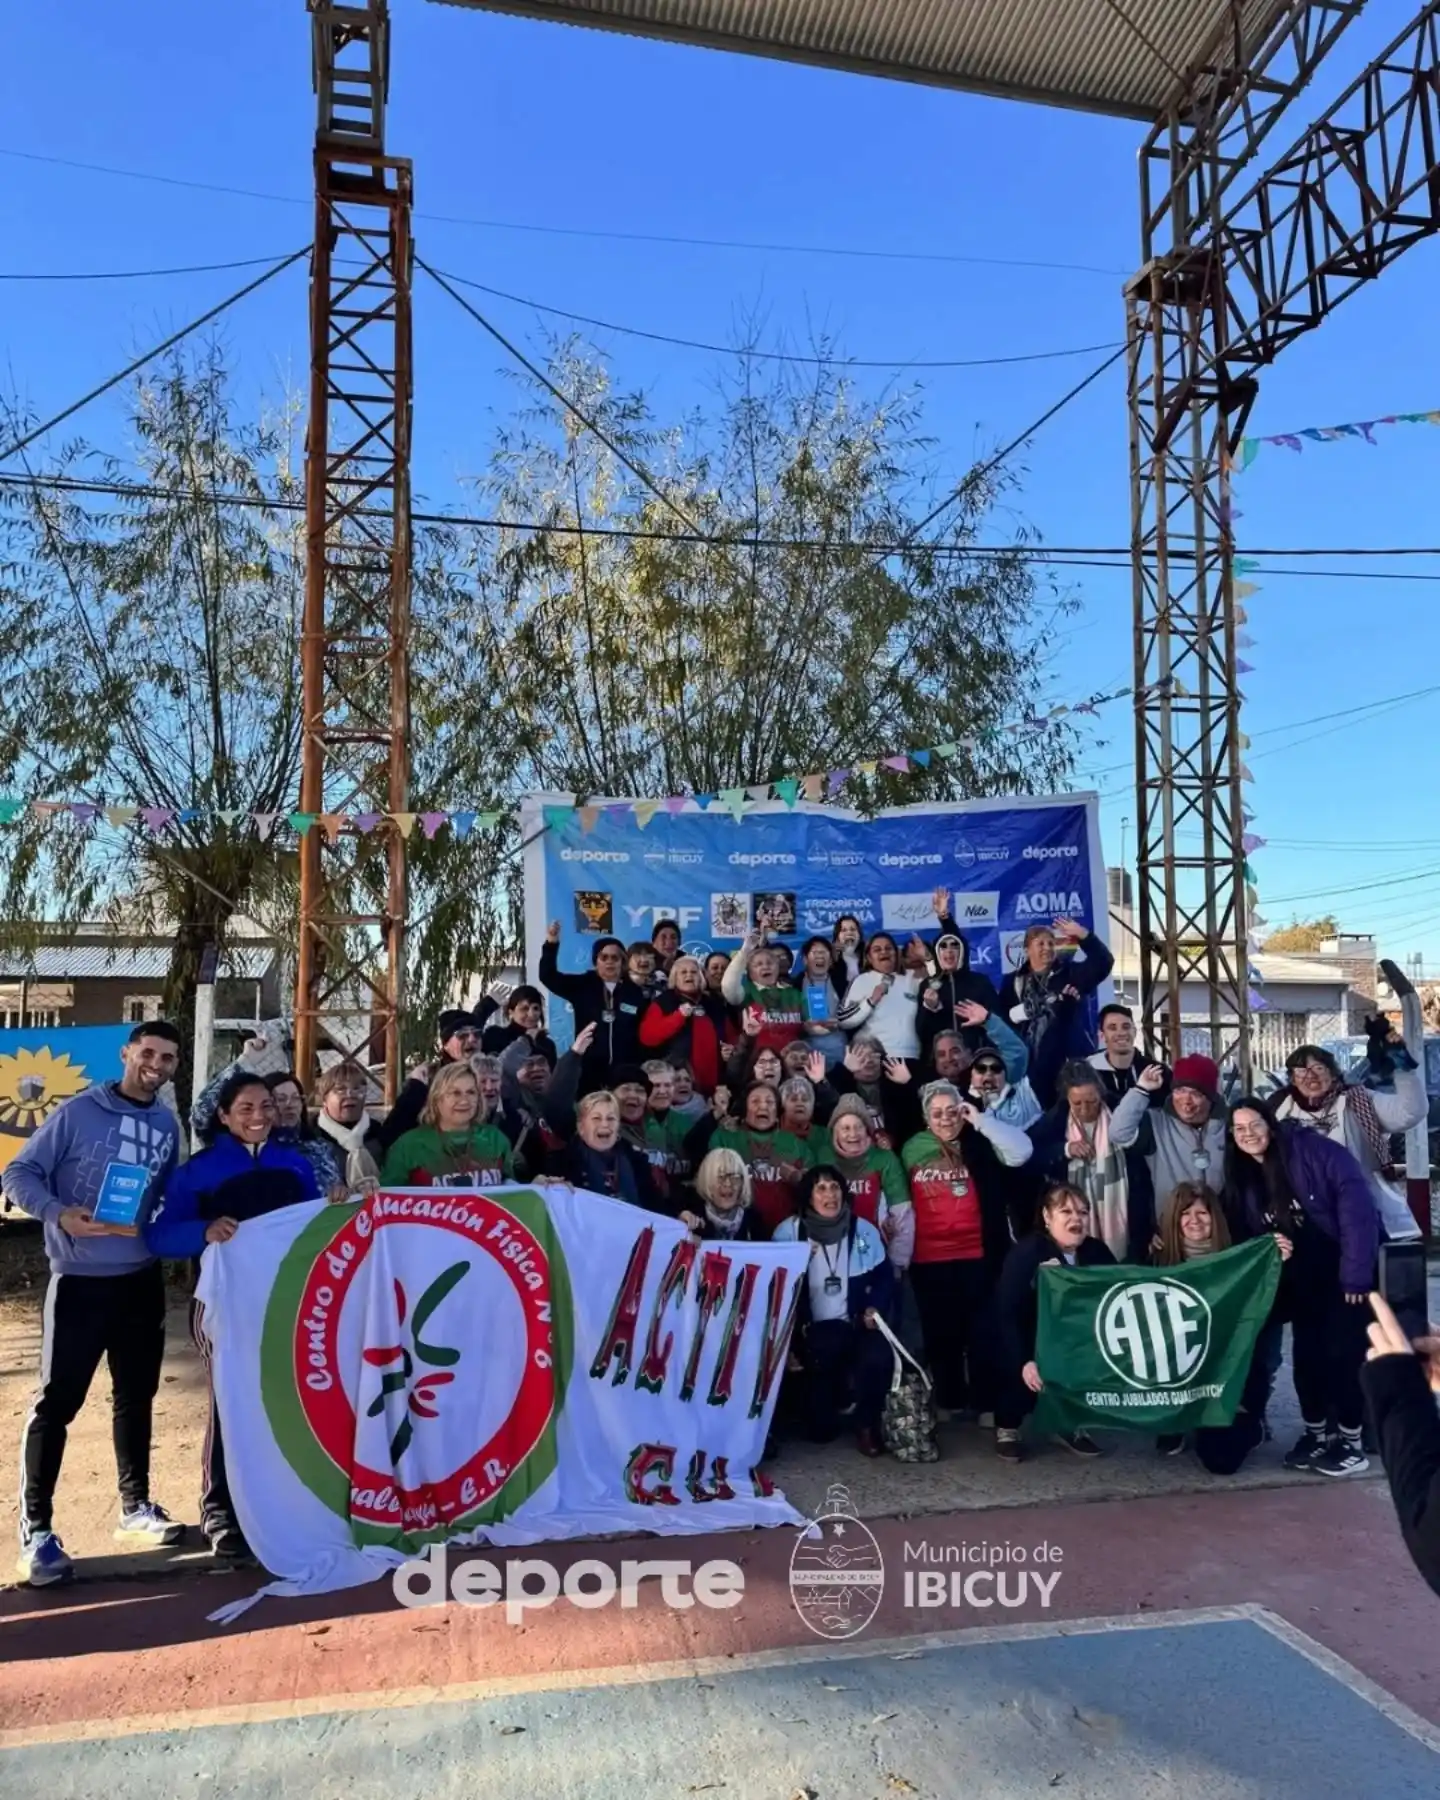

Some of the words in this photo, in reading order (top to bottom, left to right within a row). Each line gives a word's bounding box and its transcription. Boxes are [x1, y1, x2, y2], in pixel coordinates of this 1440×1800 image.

[728, 852, 797, 867] deporte
[878, 853, 943, 868] deporte
[1022, 846, 1079, 862] deporte
[1015, 891, 1083, 914] AOMA
[621, 905, 703, 929] YPF
[304, 1286, 333, 1390] Centro
[325, 1241, 355, 1280] de
[355, 1193, 484, 1238] Educación
[486, 1219, 544, 1291] Física
[1104, 1282, 1202, 1383] ATE
[1085, 1392, 1120, 1406] CENTRO
[1122, 1391, 1170, 1407] JUBILADOS
